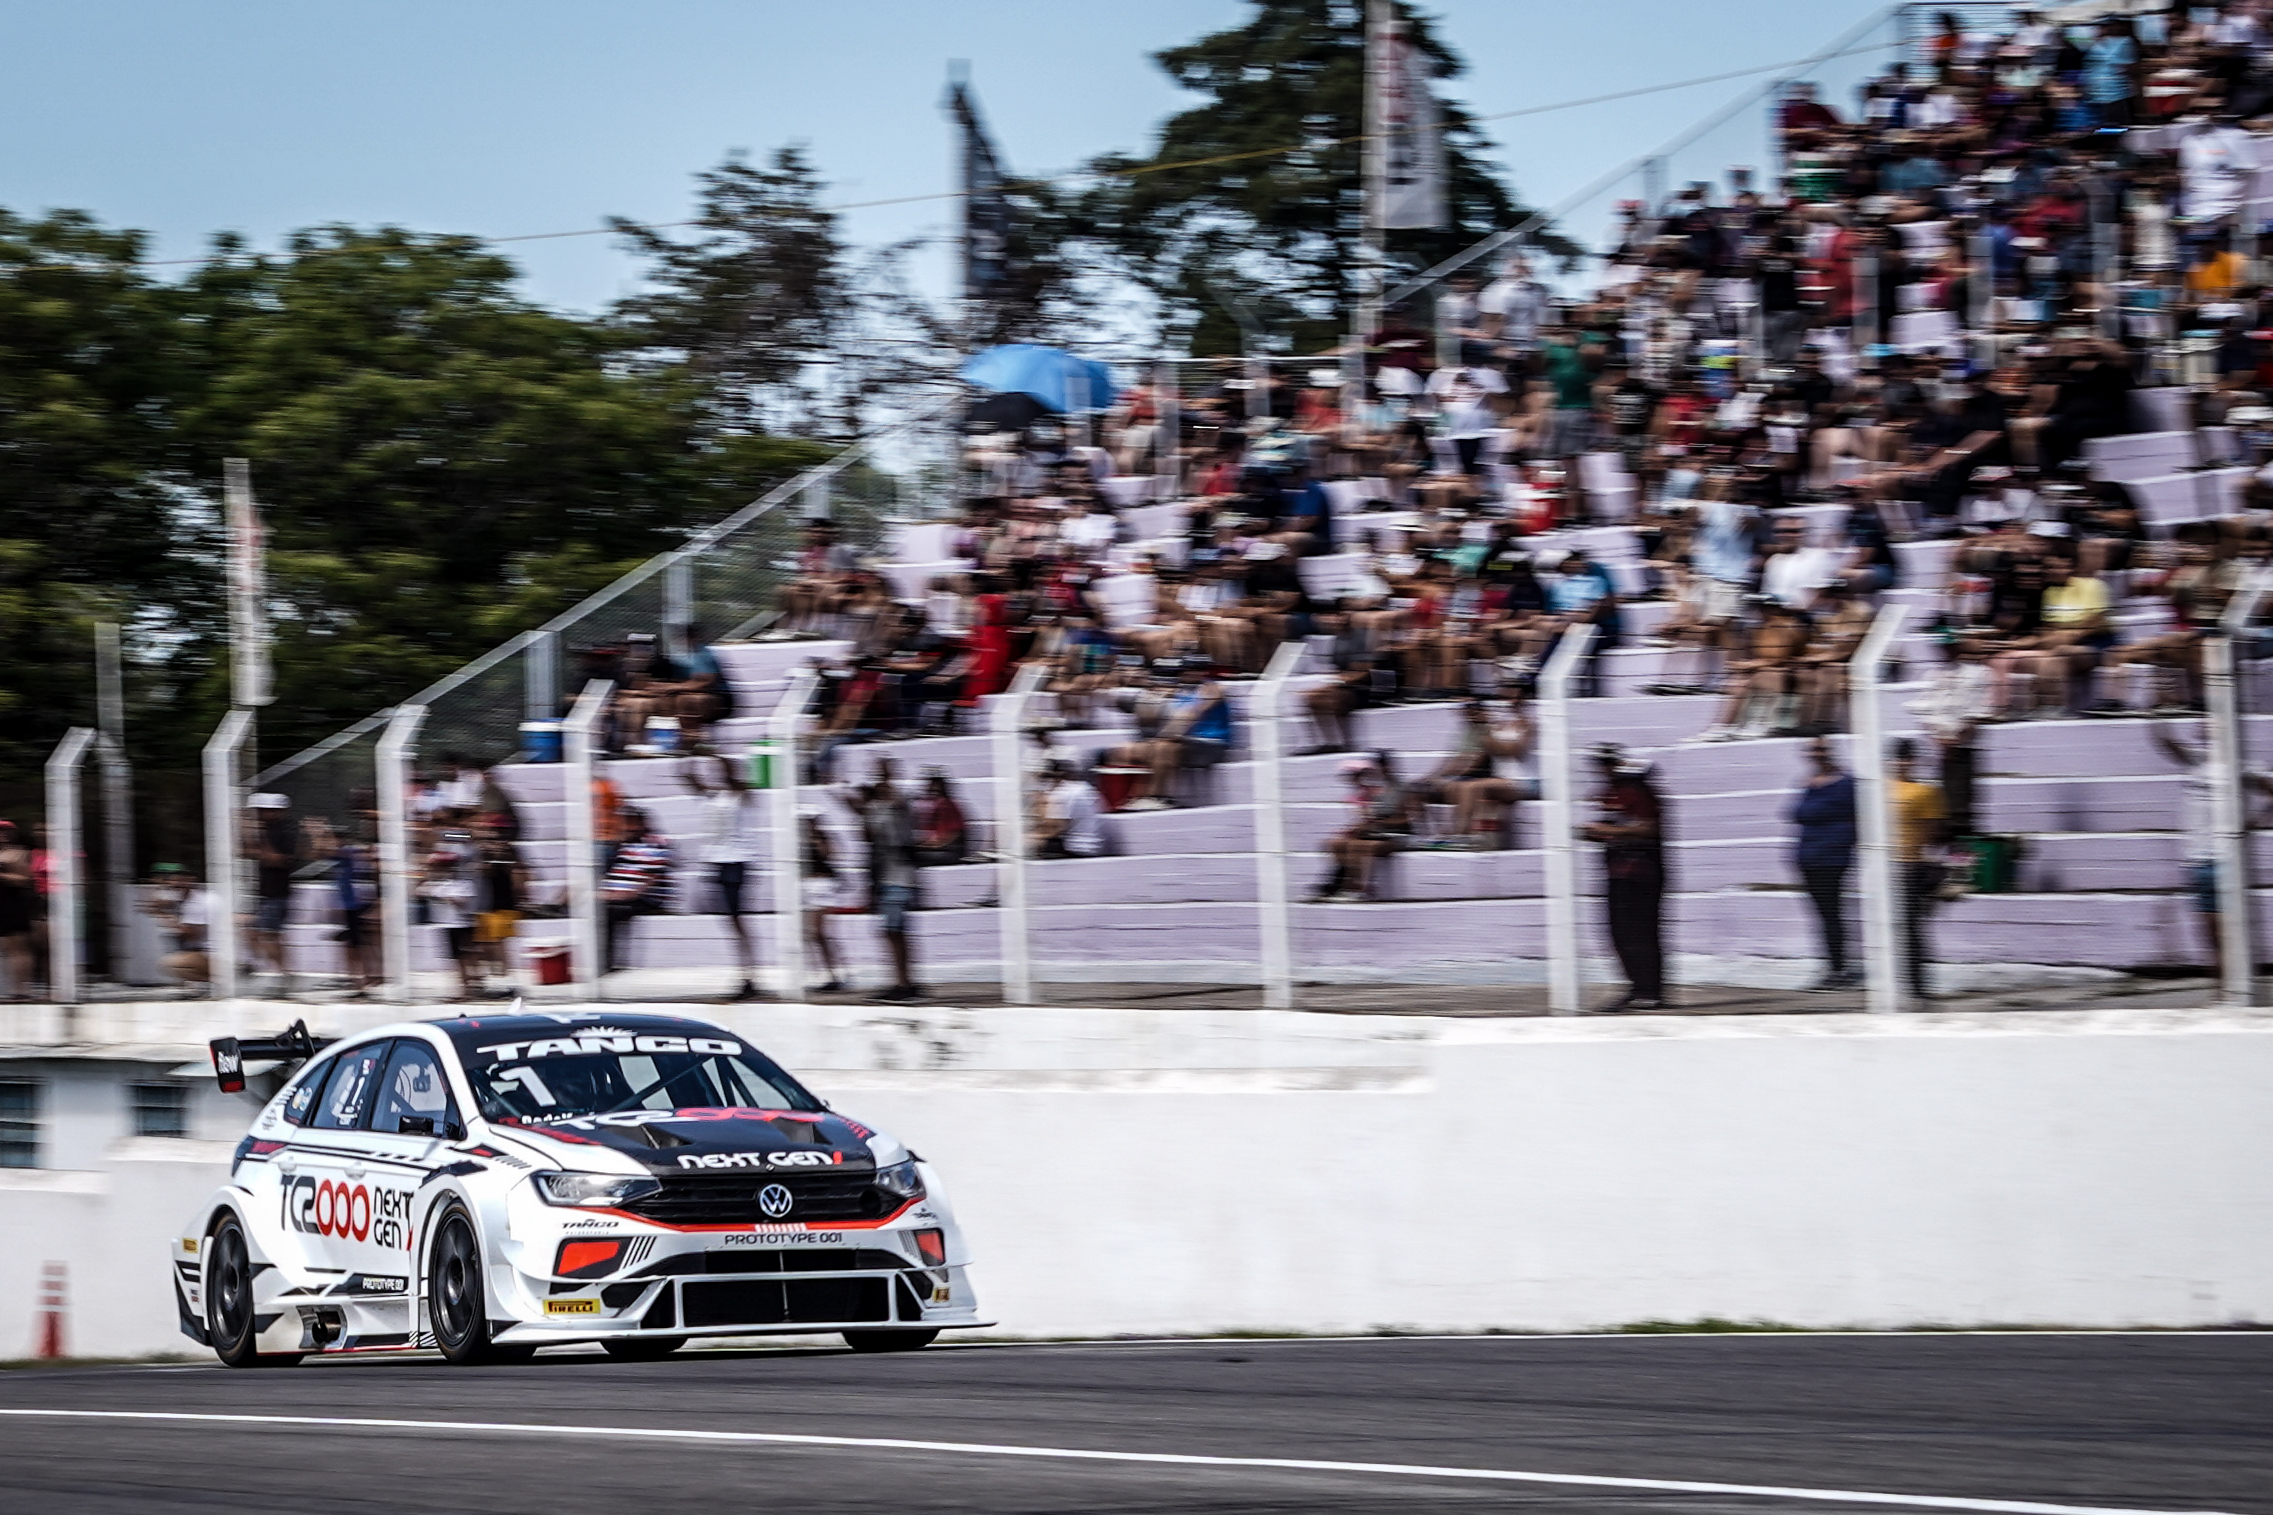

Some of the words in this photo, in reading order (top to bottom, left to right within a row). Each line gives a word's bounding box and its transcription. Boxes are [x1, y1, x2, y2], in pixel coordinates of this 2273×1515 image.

[476, 1036, 742, 1061] TANGO
[677, 1152, 760, 1169] NEXT
[280, 1173, 371, 1242] TC2000
[374, 1185, 414, 1219] NEXT
[725, 1233, 817, 1245] PROTOTYPE
[819, 1232, 843, 1244] 001
[548, 1301, 594, 1312] PIRELLI
